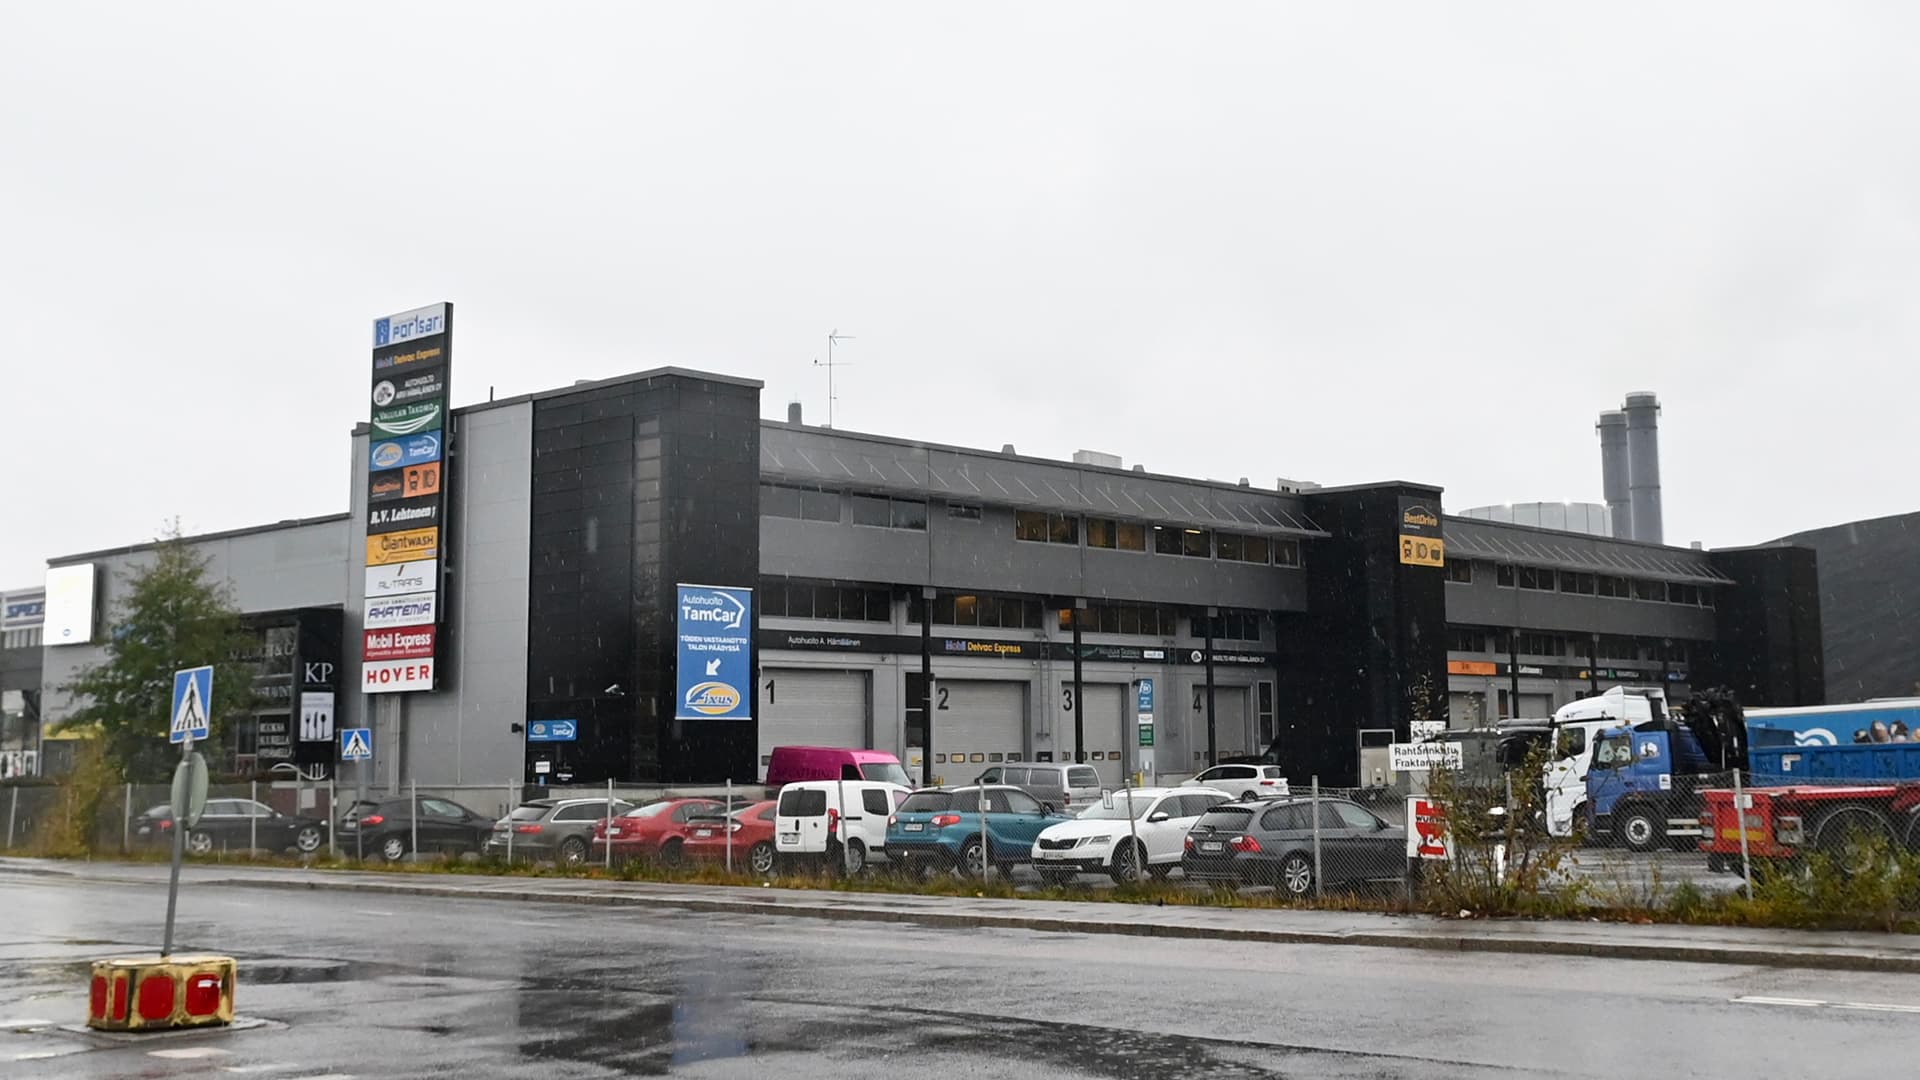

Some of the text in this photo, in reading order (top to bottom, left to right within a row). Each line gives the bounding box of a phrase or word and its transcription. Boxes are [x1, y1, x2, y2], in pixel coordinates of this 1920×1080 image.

[369, 602, 431, 618] AKATEMIA
[682, 606, 736, 622] TamCar
[367, 633, 431, 649] Mobil Express
[305, 662, 334, 683] KP
[367, 665, 430, 684] HOYER
[765, 680, 774, 705] 1
[938, 687, 949, 710] 2
[1063, 689, 1073, 711] 3
[1193, 693, 1202, 713] 4
